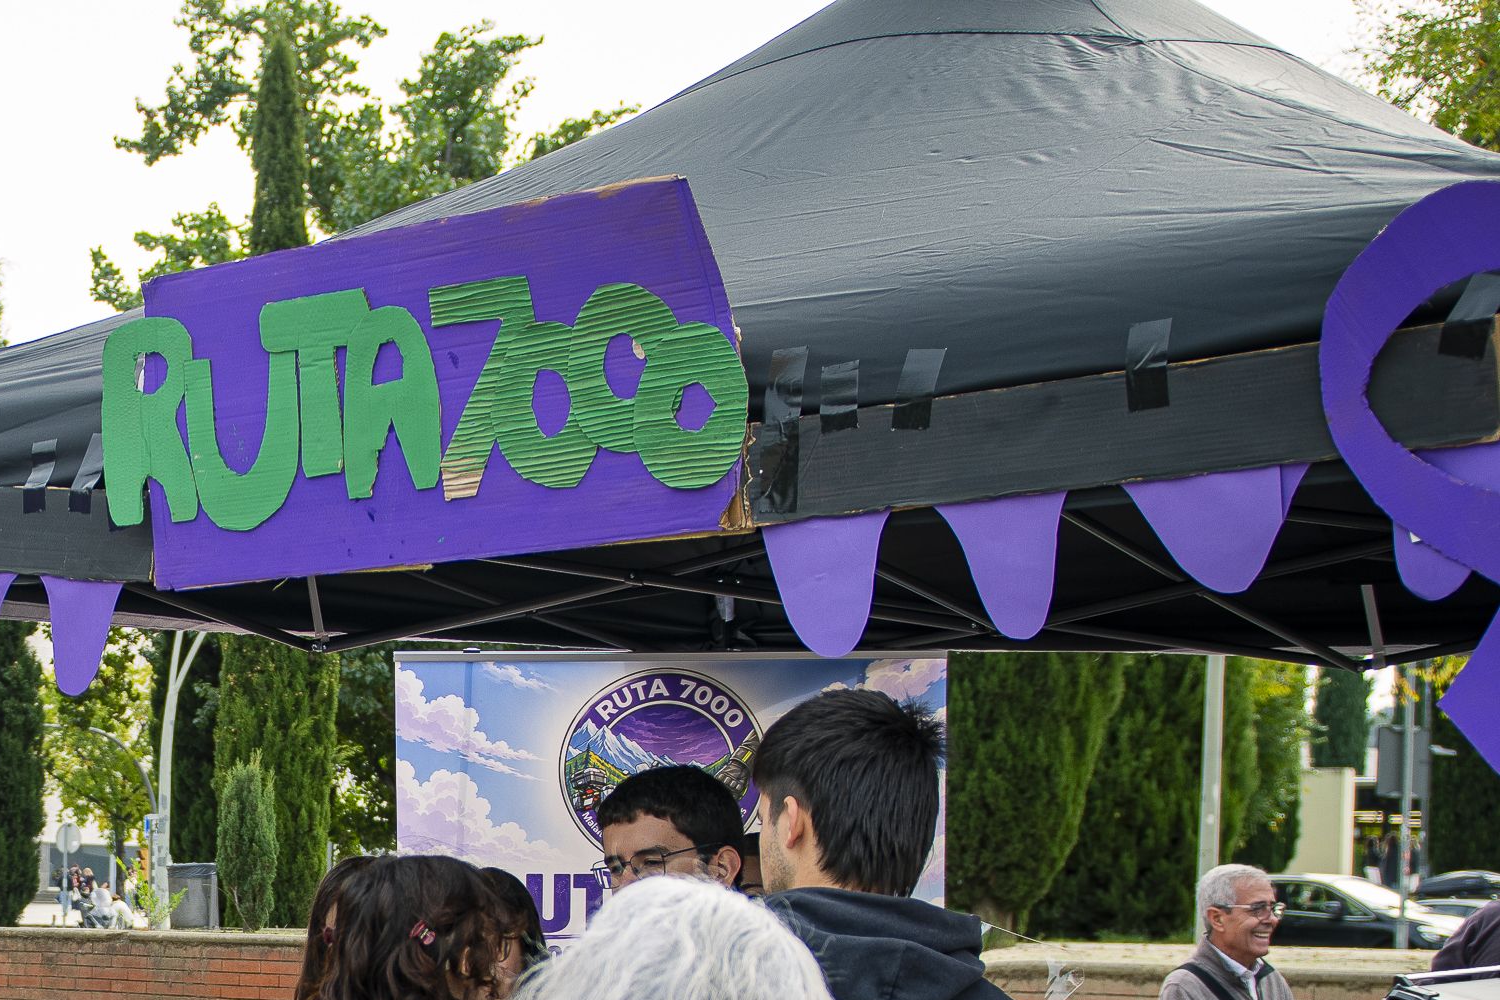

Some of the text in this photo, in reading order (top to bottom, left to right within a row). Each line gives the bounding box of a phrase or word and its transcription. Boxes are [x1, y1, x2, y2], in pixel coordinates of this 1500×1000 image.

[102, 275, 748, 531] RUTA 7000
[594, 678, 744, 728] RUTA 7000
